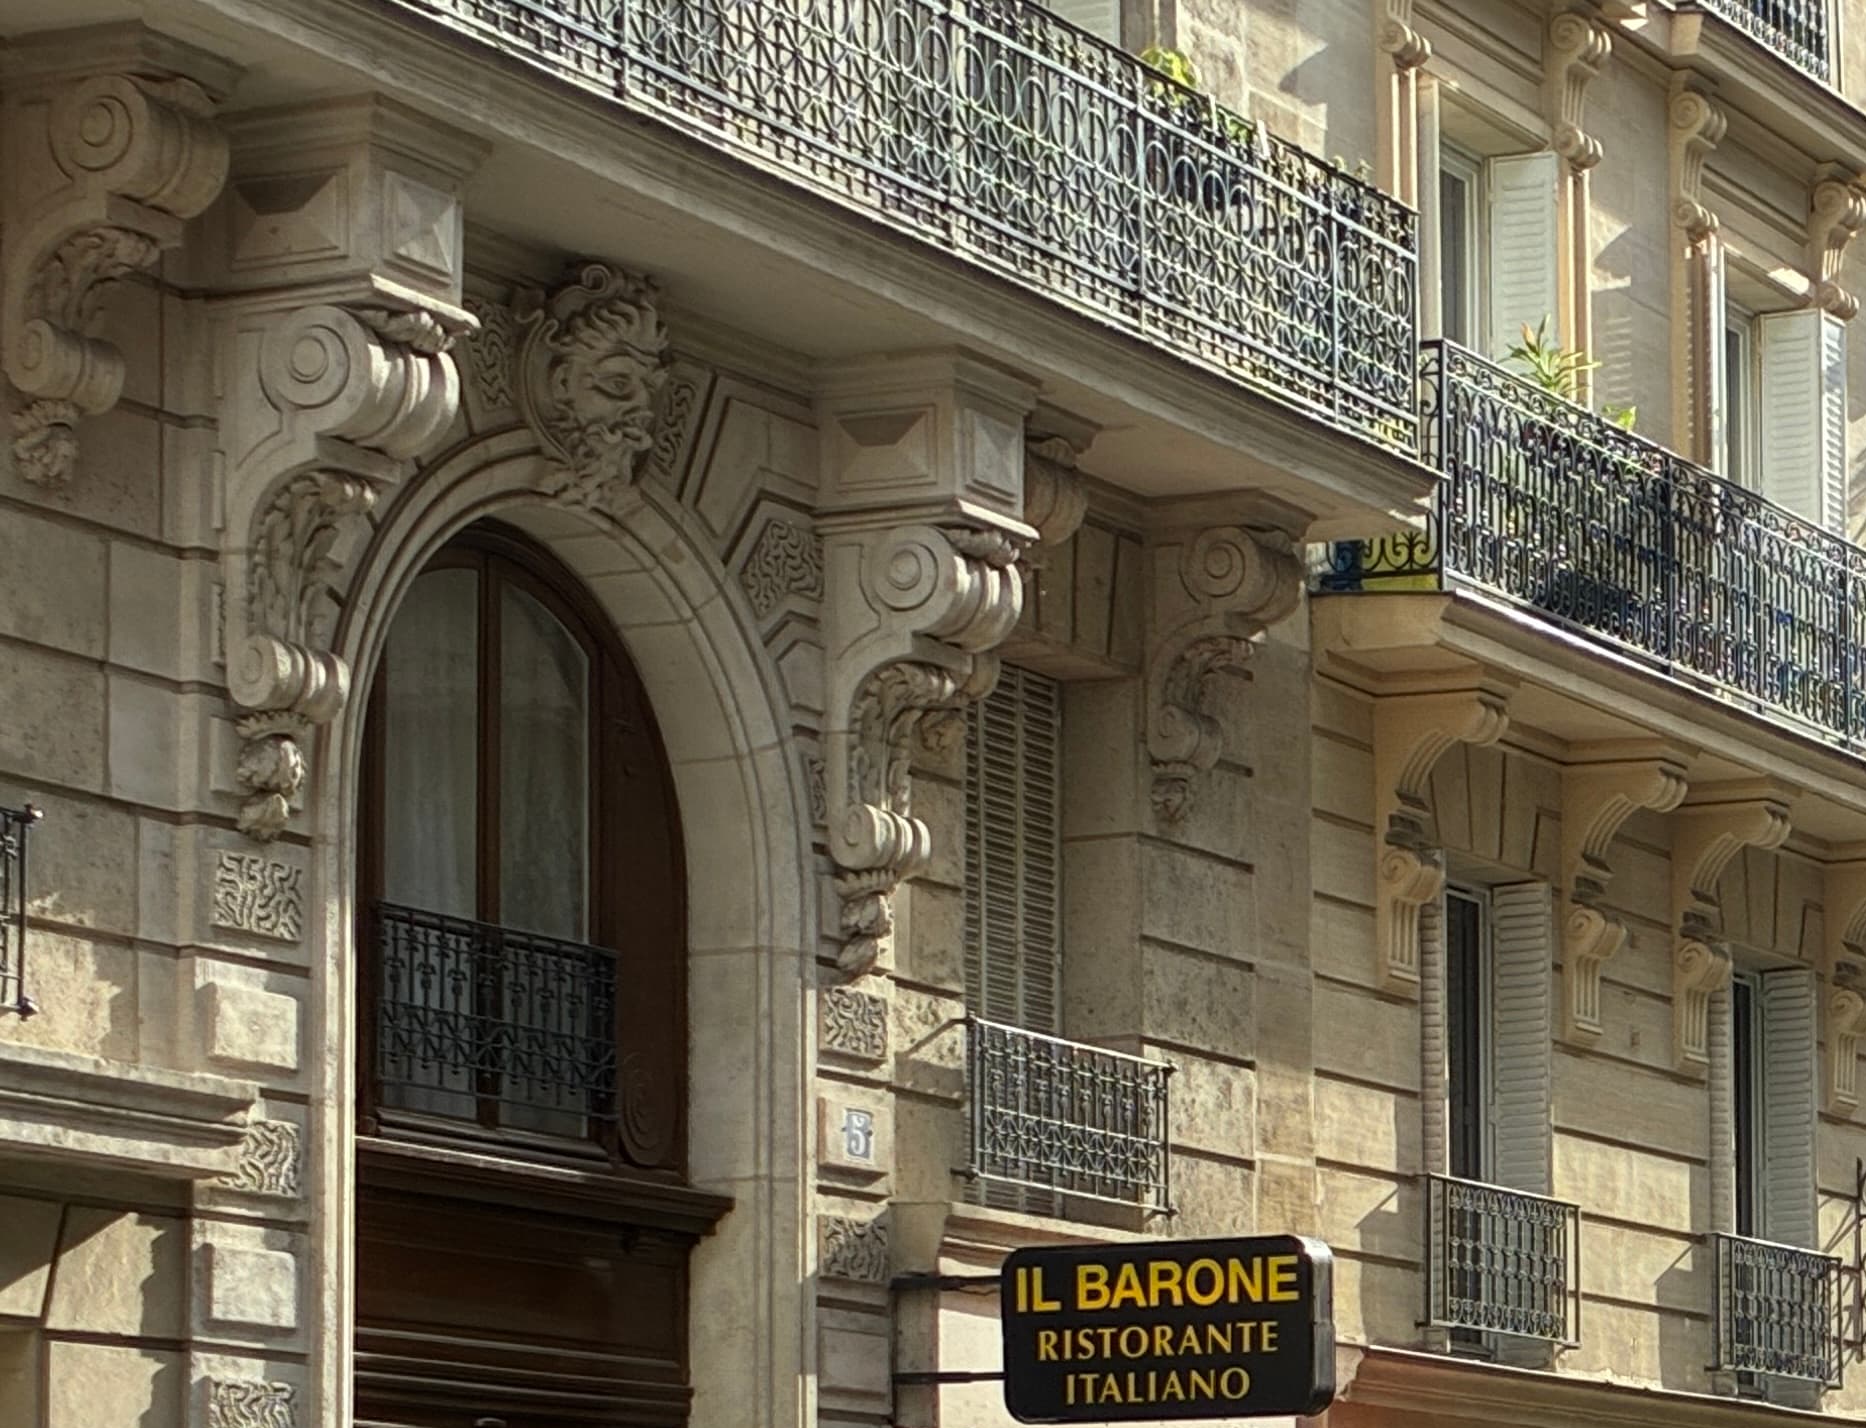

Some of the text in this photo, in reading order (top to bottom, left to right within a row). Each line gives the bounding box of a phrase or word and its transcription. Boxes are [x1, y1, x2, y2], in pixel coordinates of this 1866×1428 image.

[1016, 1255, 1299, 1312] IL BARONE
[1038, 1321, 1279, 1361] RISTORANTE
[1065, 1368, 1250, 1404] ITALIANO
